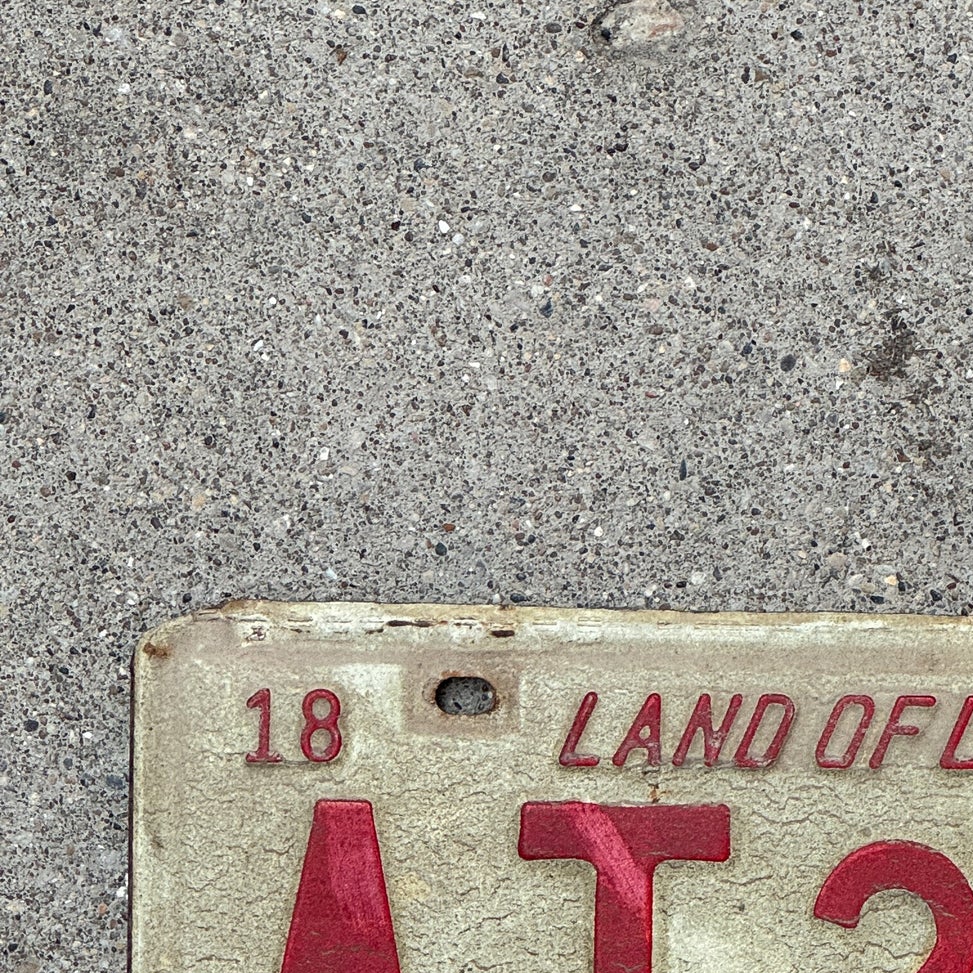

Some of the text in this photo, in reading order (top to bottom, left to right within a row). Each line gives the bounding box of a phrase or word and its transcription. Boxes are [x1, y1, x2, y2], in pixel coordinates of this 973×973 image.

[245, 687, 343, 765] 18
[559, 690, 796, 769] LAND
[814, 693, 937, 771] OF
